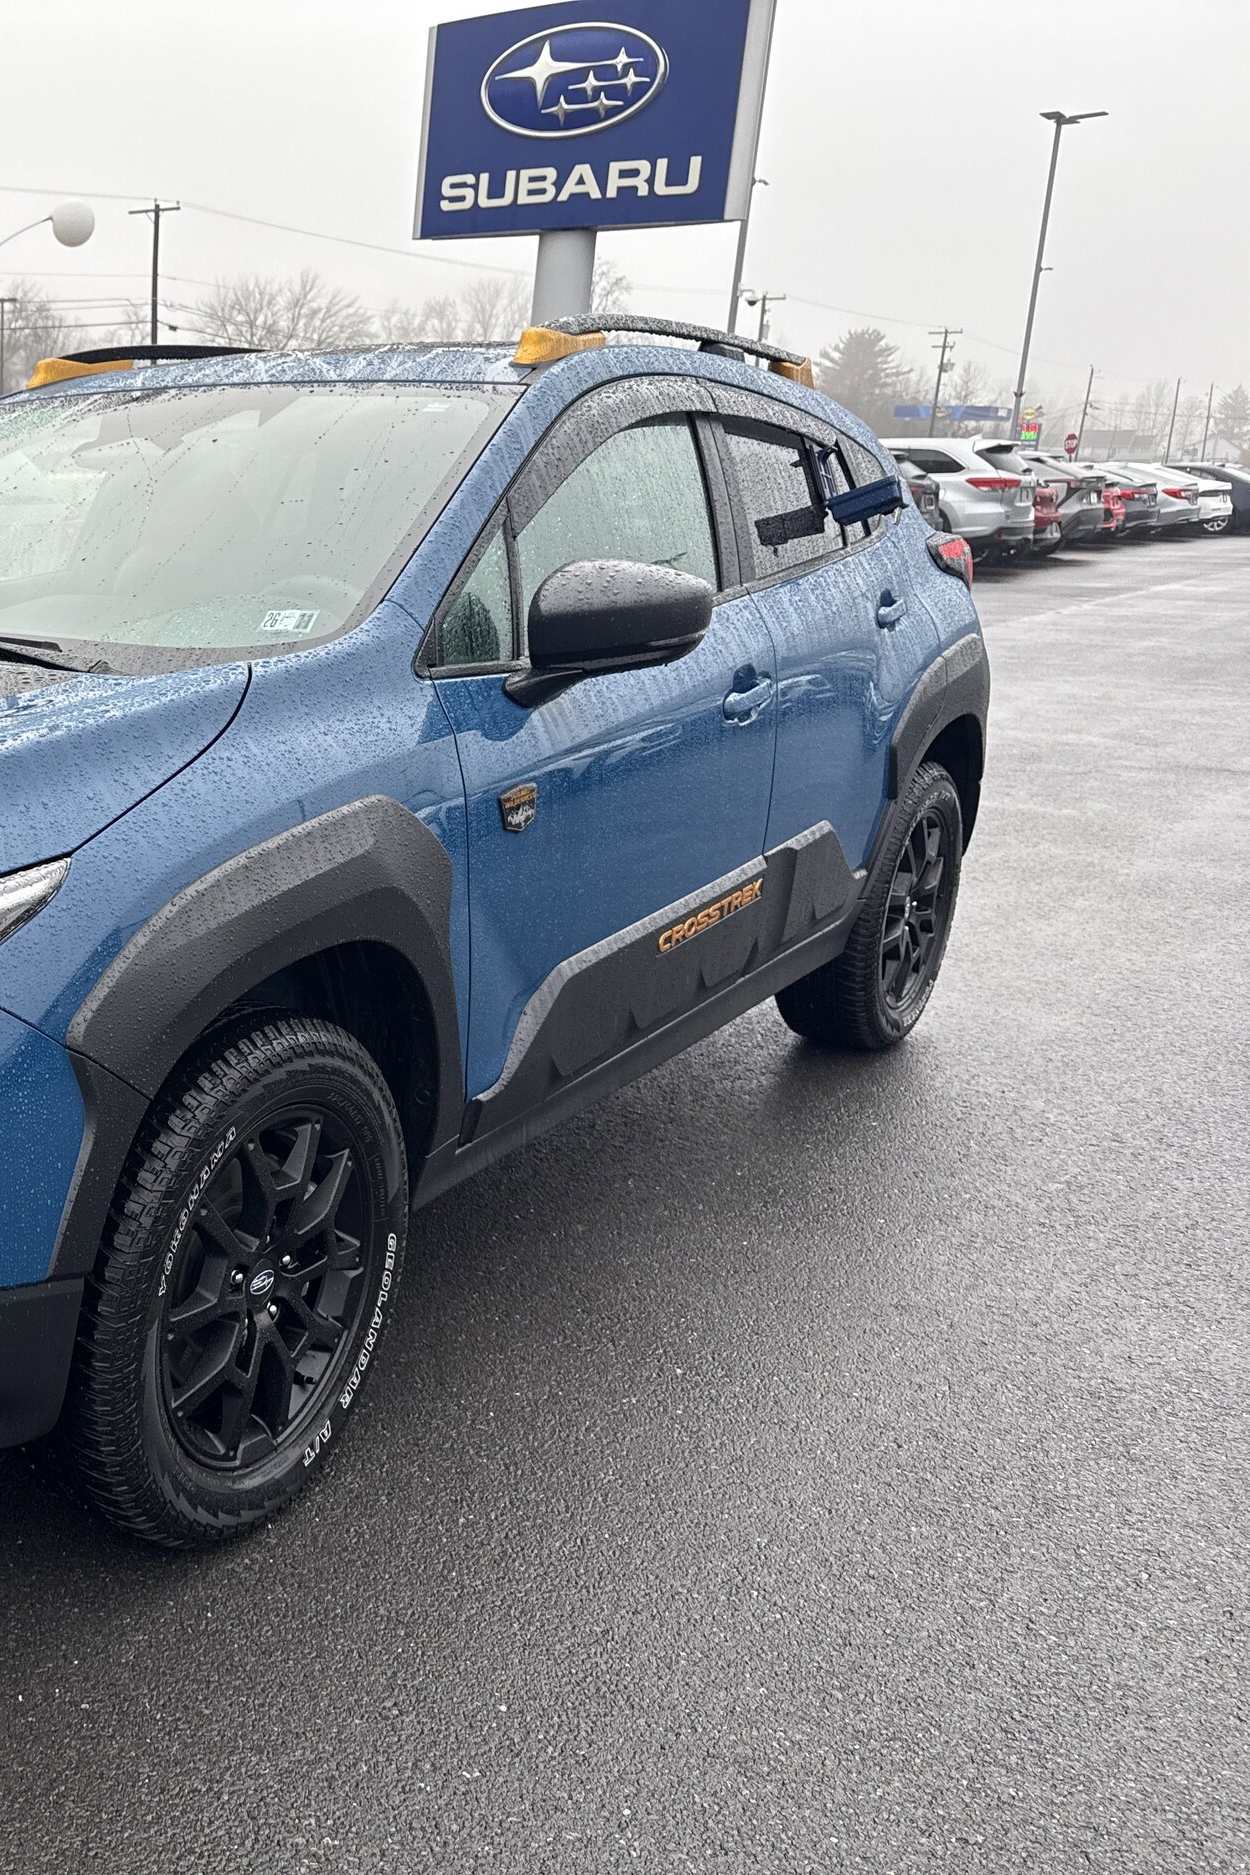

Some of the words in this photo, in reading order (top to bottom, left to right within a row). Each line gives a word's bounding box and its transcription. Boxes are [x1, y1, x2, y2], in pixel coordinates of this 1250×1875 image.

[439, 155, 703, 212] SUBARU
[1065, 438, 1078, 450] STOP
[263, 612, 282, 628] 26
[658, 878, 764, 953] CROSSTREK
[158, 1126, 237, 1297] YOKOHAMA
[340, 1233, 397, 1409] GEOLANDAR
[303, 1420, 332, 1467] A/T
